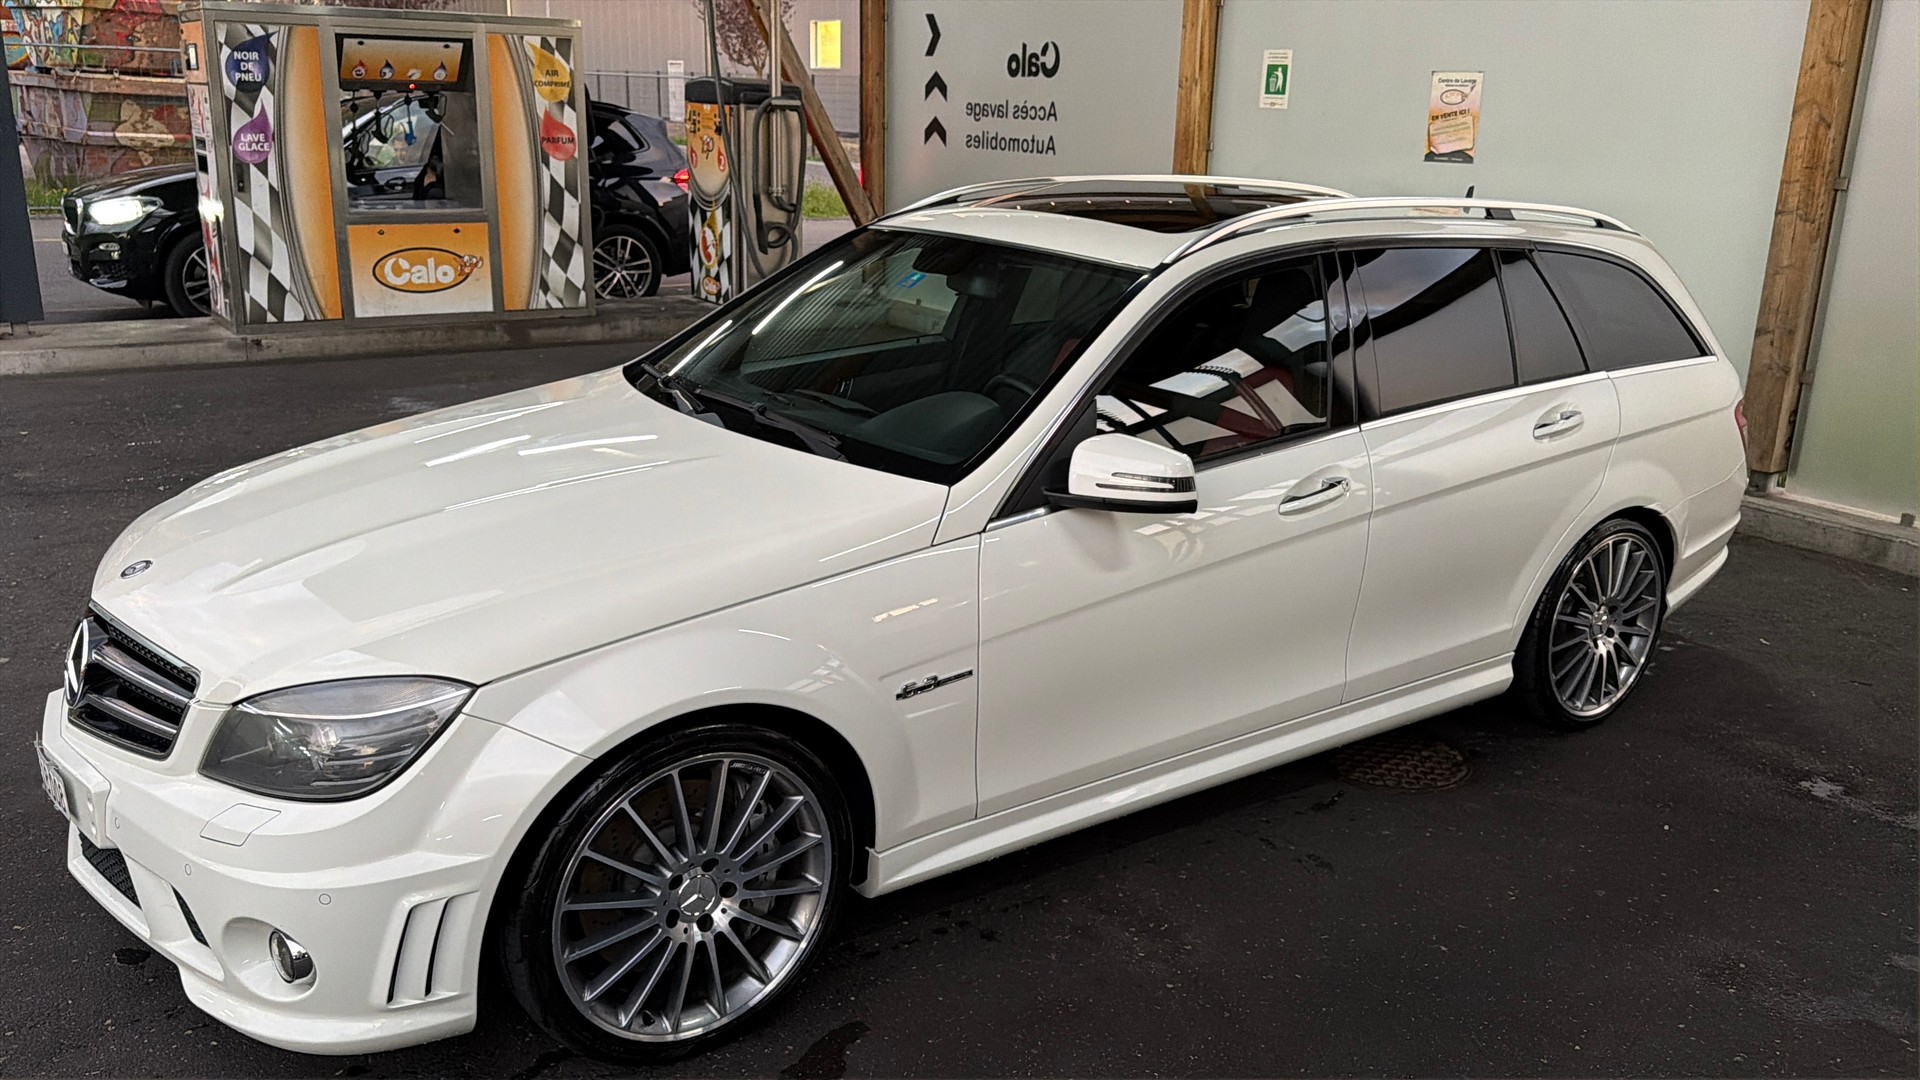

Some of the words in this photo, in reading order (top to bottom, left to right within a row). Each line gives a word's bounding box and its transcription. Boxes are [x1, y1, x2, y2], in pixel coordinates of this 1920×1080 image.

[233, 51, 259, 60] NOIR
[240, 62, 254, 71] DE
[235, 72, 262, 82] PNEU
[545, 69, 559, 77] AIR
[1440, 110, 1458, 120] VENTE
[241, 133, 266, 142] LAVE
[541, 136, 574, 144] PARFUM
[238, 142, 270, 151] GLACE
[384, 257, 455, 285] Calo
